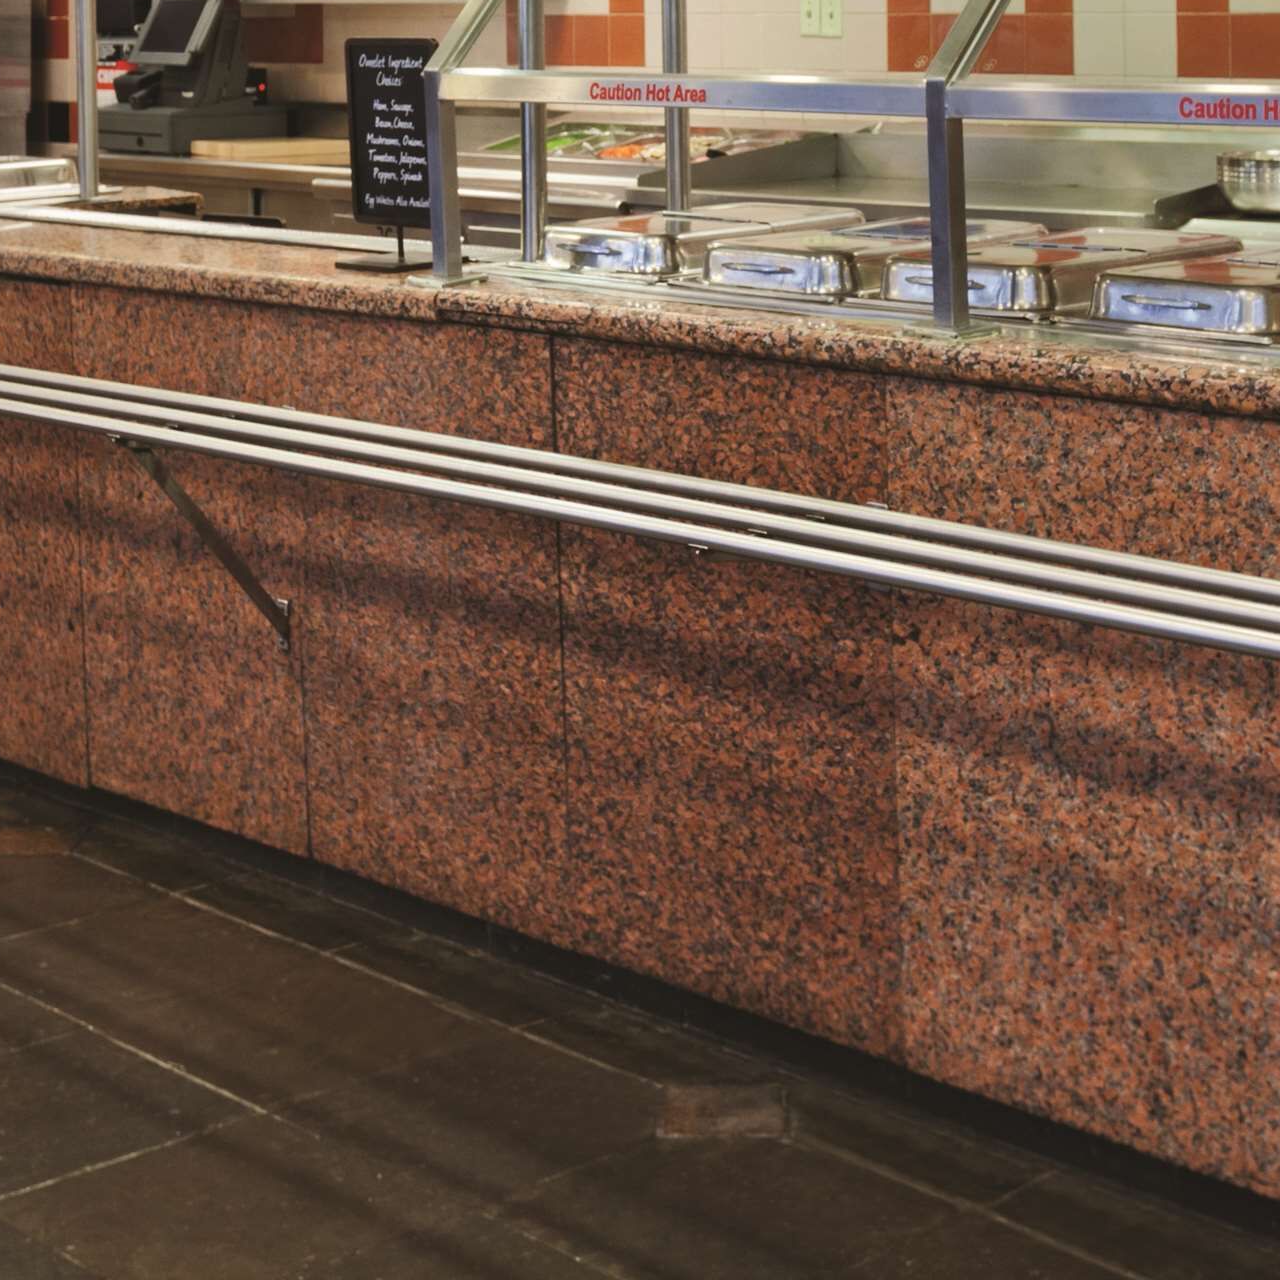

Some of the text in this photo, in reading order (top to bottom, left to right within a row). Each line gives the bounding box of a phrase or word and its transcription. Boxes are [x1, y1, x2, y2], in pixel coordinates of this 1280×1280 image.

[358, 53, 423, 74] Omelet Ingredient
[375, 71, 402, 87] Choices
[589, 82, 707, 103] Caution Hot Area
[1178, 96, 1257, 120] Caution
